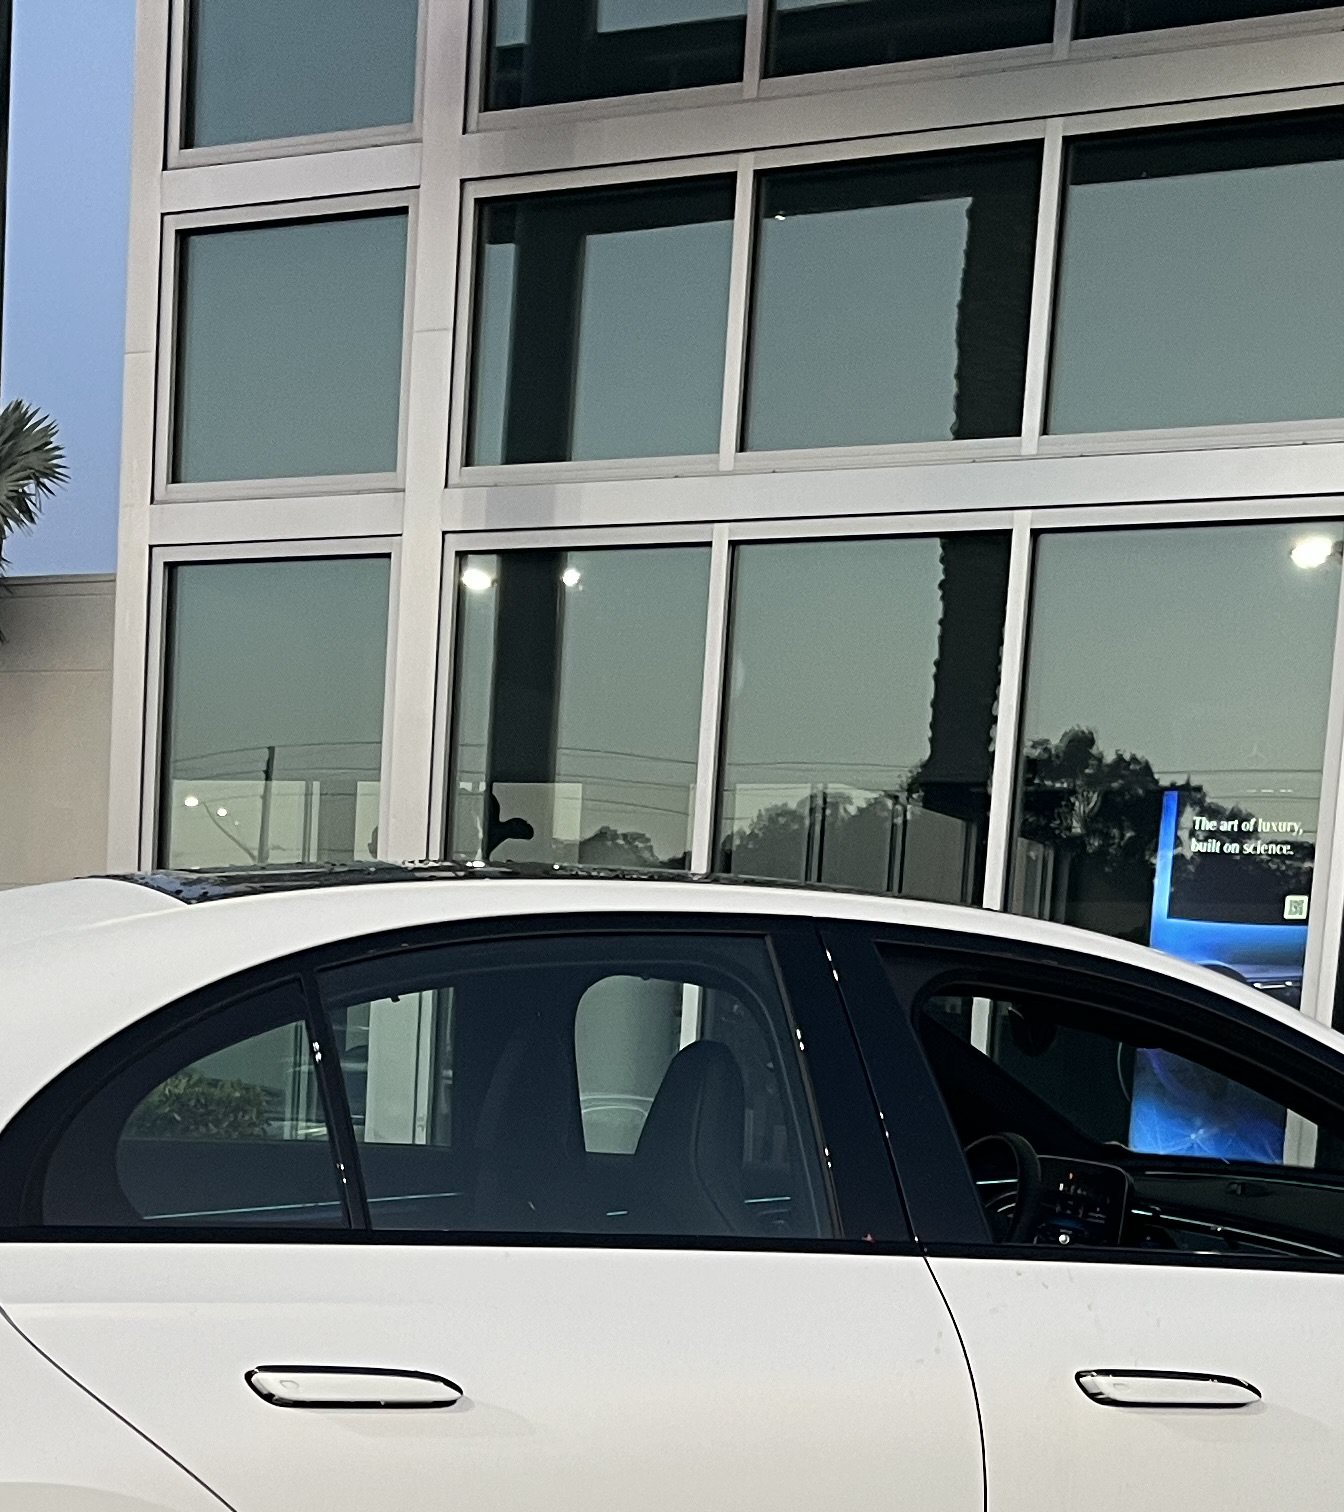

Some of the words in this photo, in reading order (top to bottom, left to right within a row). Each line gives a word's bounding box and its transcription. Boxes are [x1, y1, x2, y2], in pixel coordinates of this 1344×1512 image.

[1193, 816, 1217, 831] The
[1219, 819, 1239, 832] art
[1241, 818, 1257, 832] of
[1258, 818, 1304, 836] luxury,
[1190, 838, 1221, 853] built
[1223, 842, 1240, 854] on
[1242, 839, 1294, 855] science.
